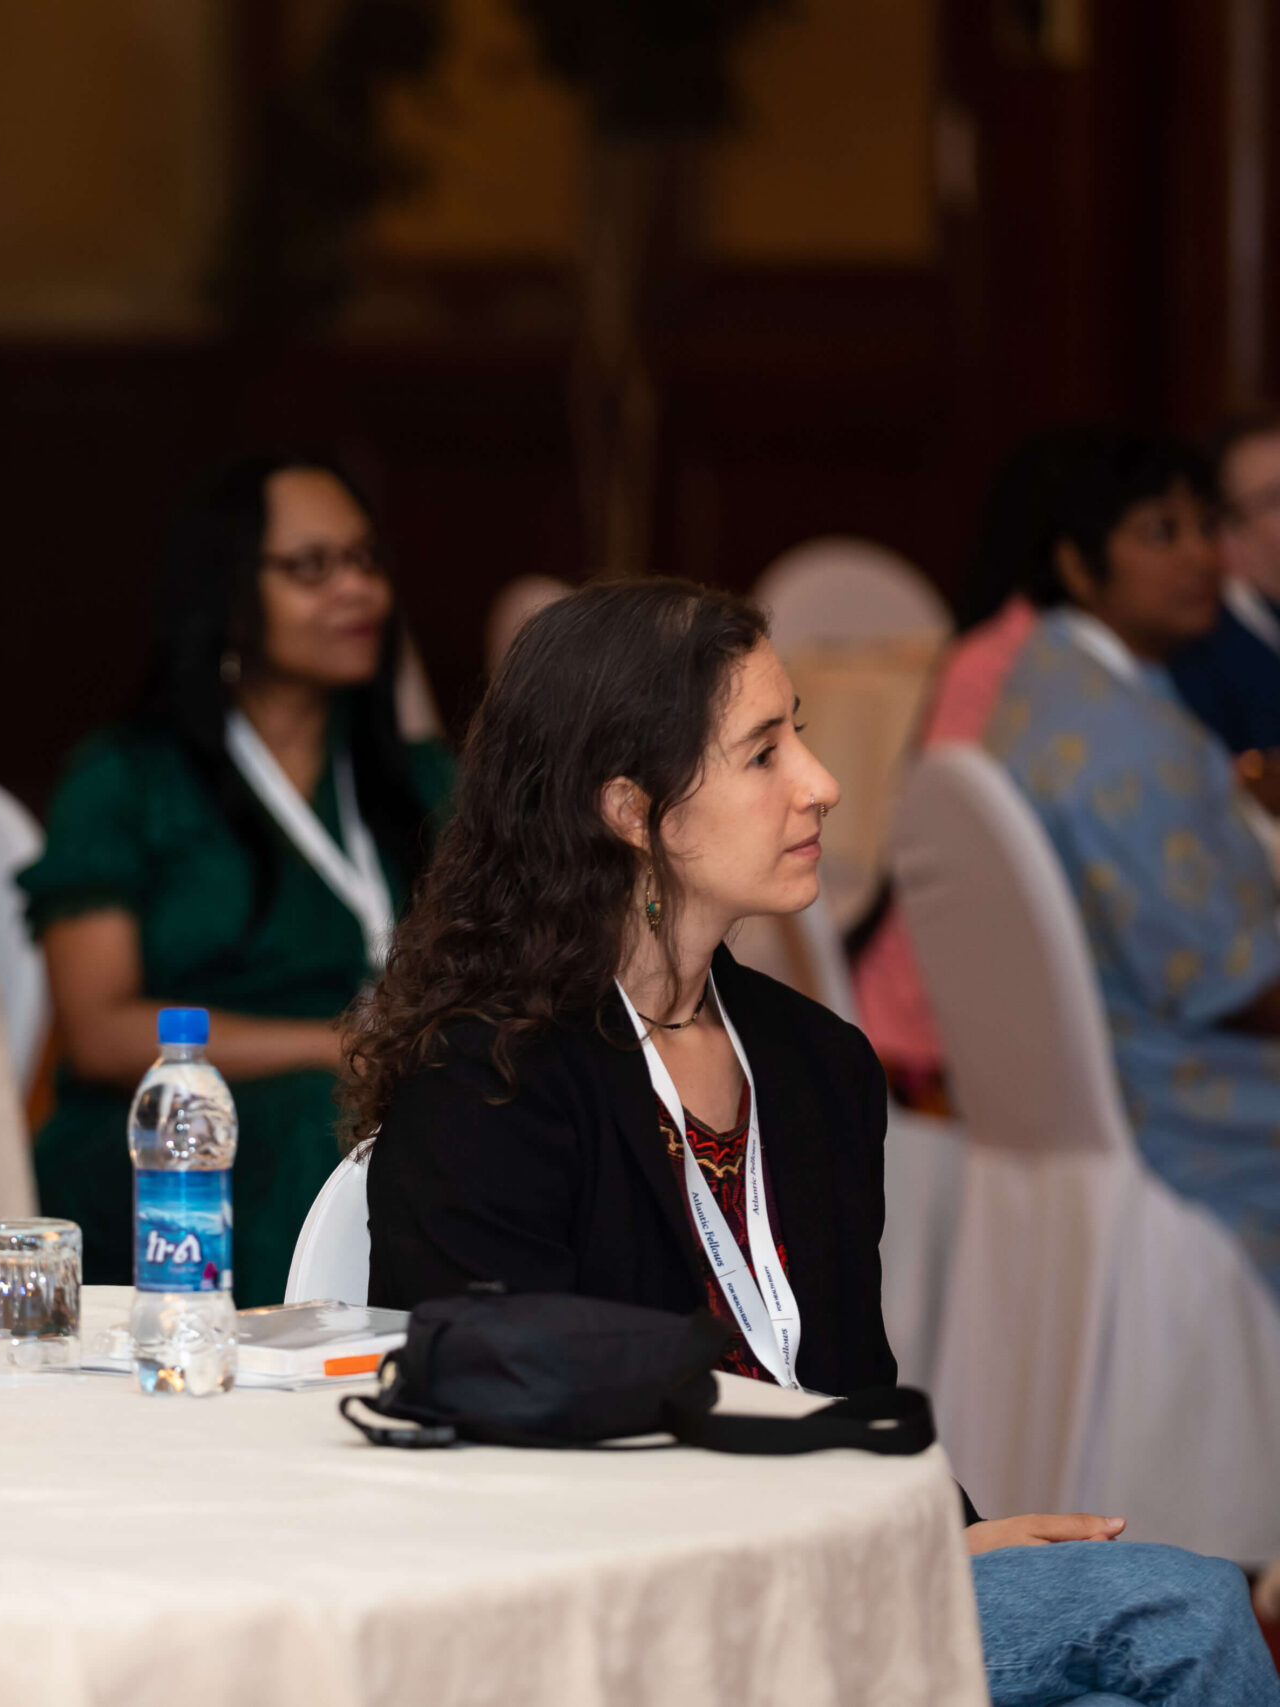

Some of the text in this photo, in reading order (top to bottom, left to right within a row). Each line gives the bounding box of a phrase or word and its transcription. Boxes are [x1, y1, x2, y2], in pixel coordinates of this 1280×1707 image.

[751, 1176, 760, 1216] Atlantic
[692, 1191, 725, 1267] Atlantic Fellows
[727, 1282, 753, 1332] FOR HEALTH EQUITY
[775, 1301, 783, 1312] FOR
